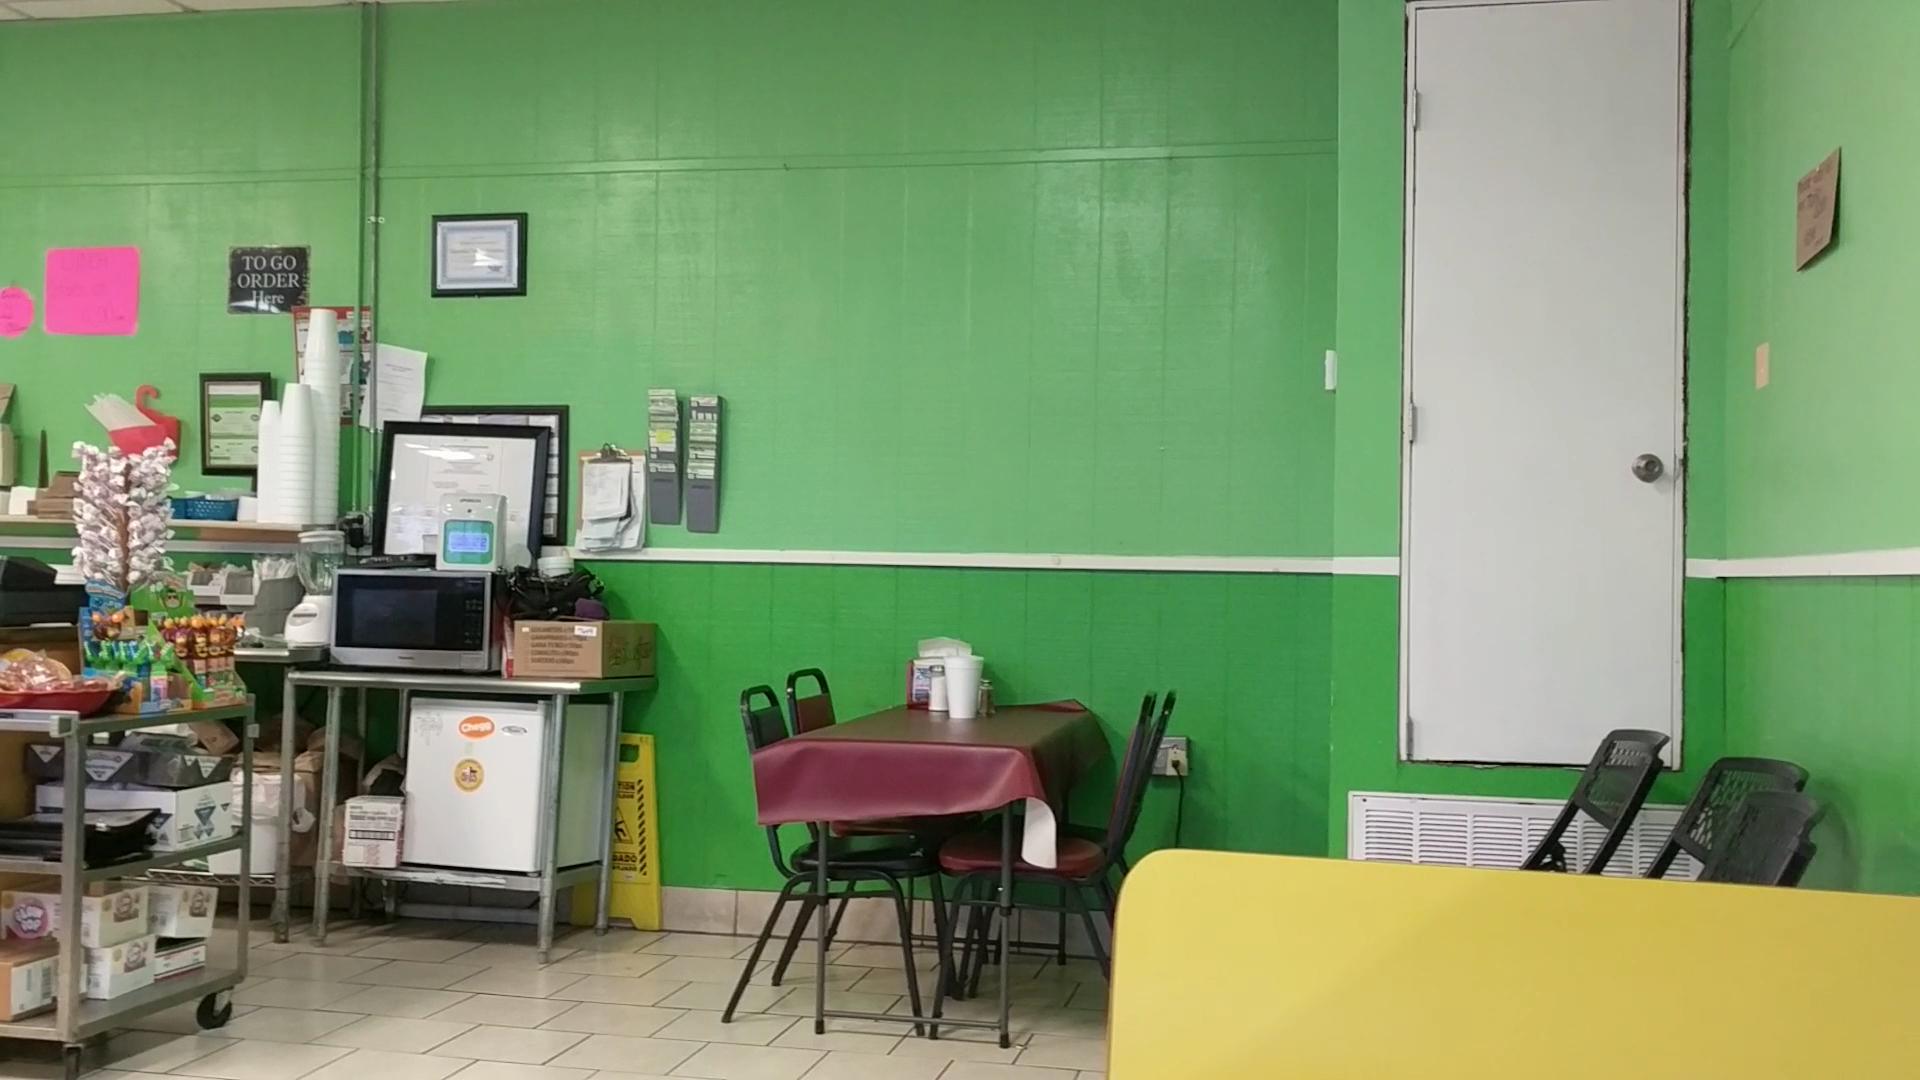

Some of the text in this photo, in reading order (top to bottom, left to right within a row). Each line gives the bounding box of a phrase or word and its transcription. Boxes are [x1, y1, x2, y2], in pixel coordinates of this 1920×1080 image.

[241, 255, 297, 271] TO GO
[237, 272, 300, 289] ORDER
[252, 290, 285, 305] Here
